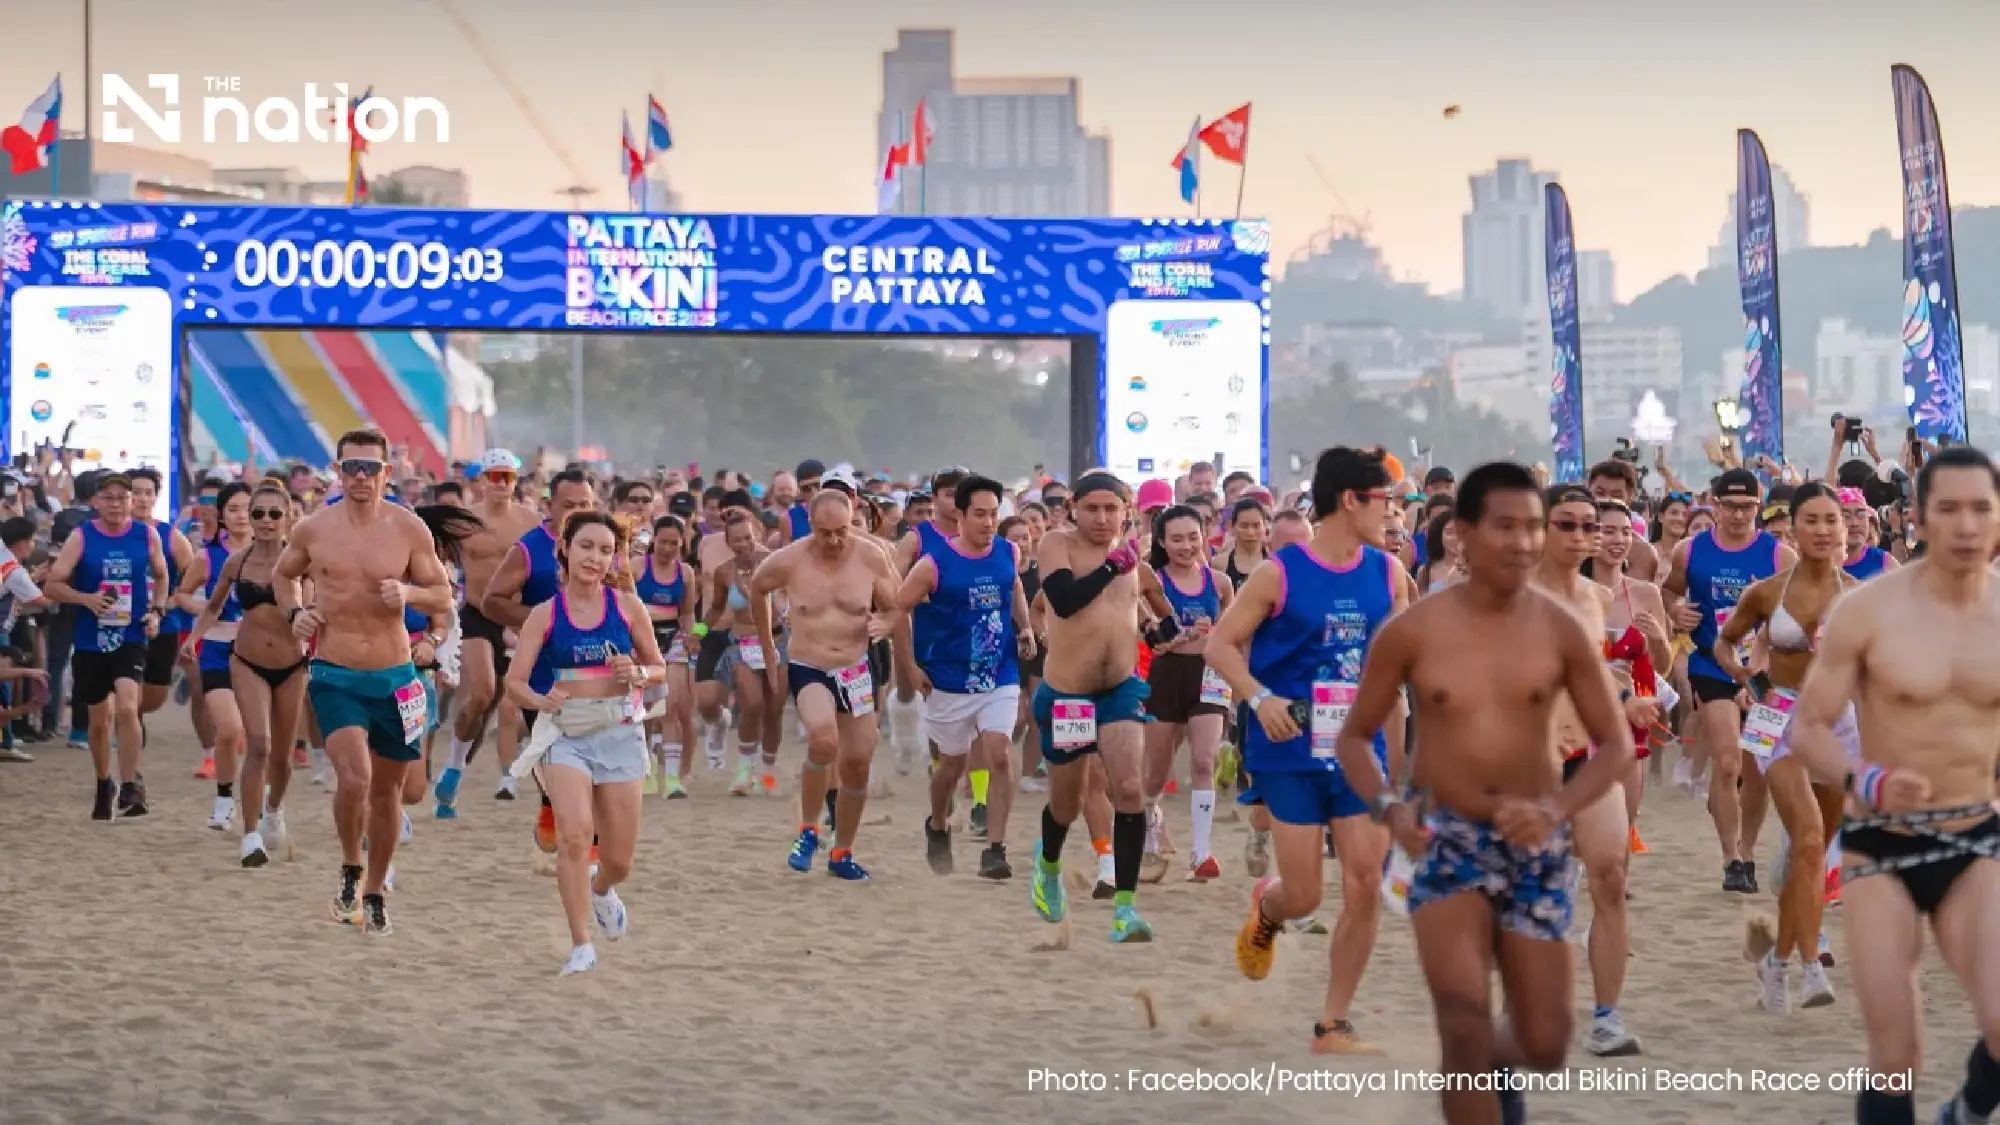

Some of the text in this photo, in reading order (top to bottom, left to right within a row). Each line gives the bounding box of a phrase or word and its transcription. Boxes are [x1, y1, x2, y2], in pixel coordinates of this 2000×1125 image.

[567, 215, 717, 249] PATTAYA
[64, 250, 96, 264] THE
[567, 248, 717, 266] INTERNATIONAL
[822, 245, 996, 274] CENTRAL
[1131, 263, 1215, 276] THE CORAL
[831, 276, 986, 306] PATTAYA
[1129, 276, 1215, 289] AND PEARL
[566, 309, 626, 326] BEACH
[628, 309, 677, 327] RACE
